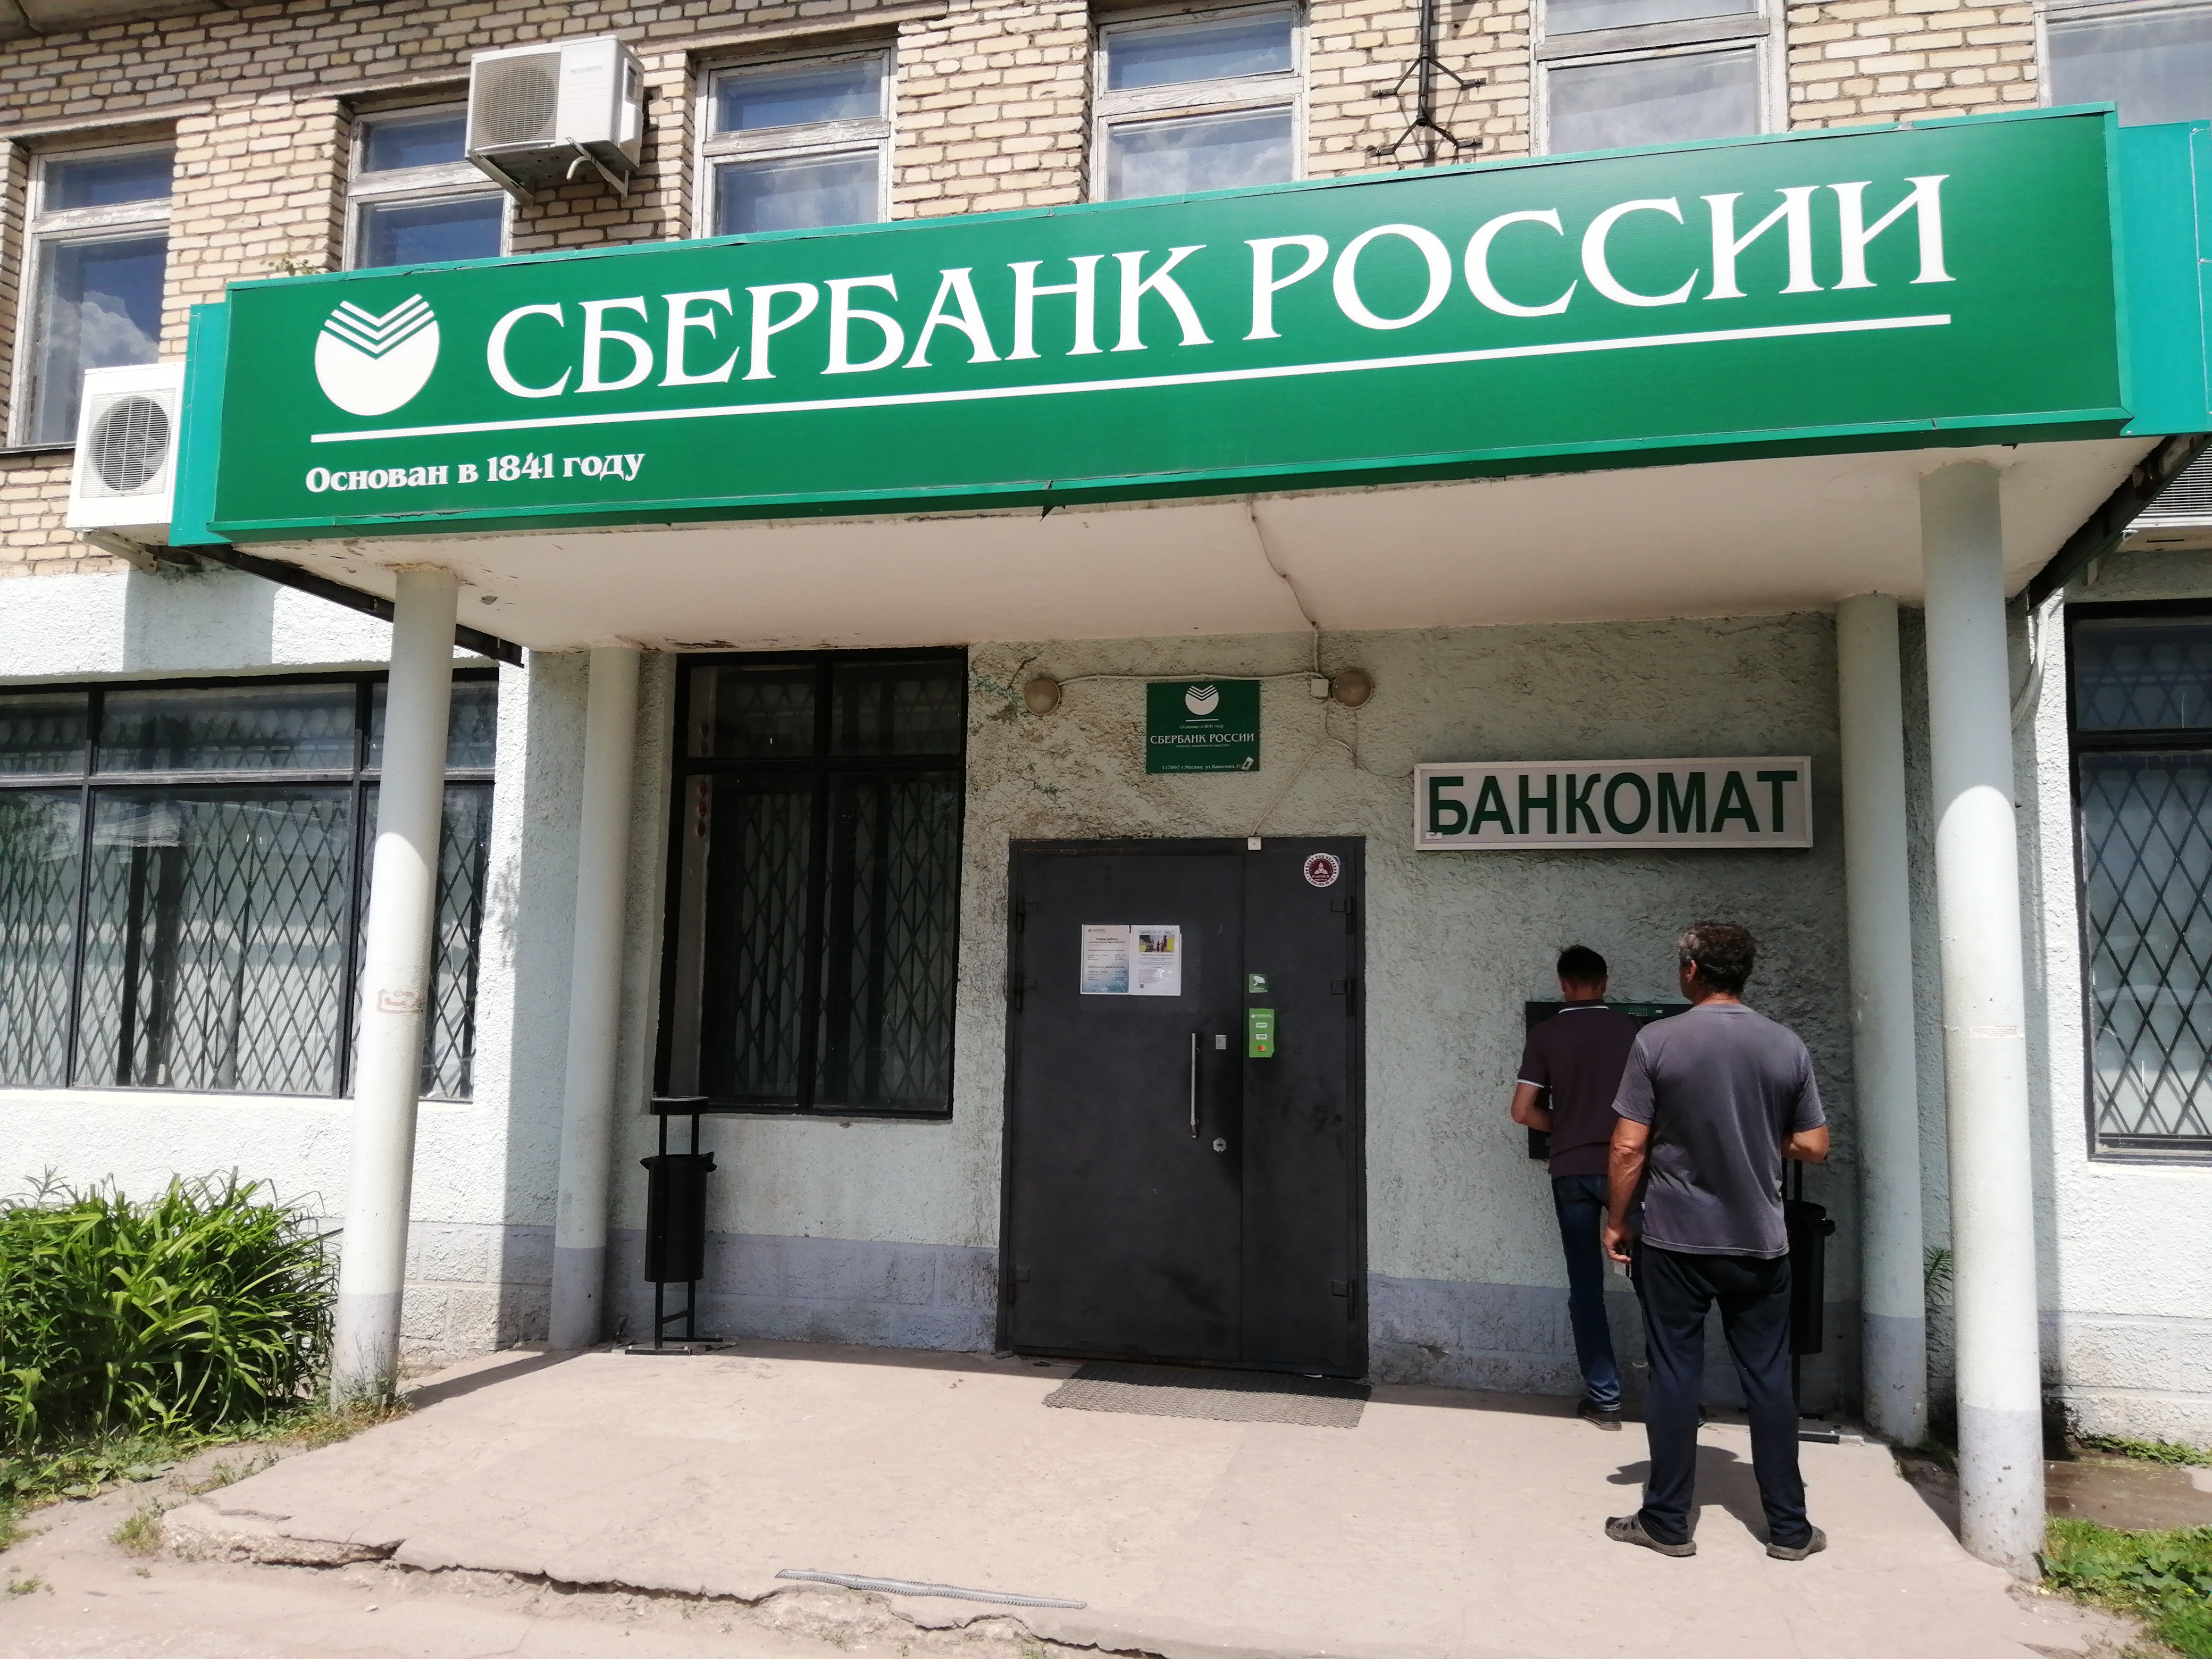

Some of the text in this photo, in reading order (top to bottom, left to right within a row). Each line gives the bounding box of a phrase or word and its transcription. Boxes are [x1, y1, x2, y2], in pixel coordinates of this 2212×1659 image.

[487, 174, 1956, 398] СБЕРБАНК РОССИИ
[305, 452, 645, 493] Основан в 1841 году
[1150, 733, 1255, 744] СБЕРБАНК РОССИИ
[1428, 770, 1798, 835] БАНКОМАТ
